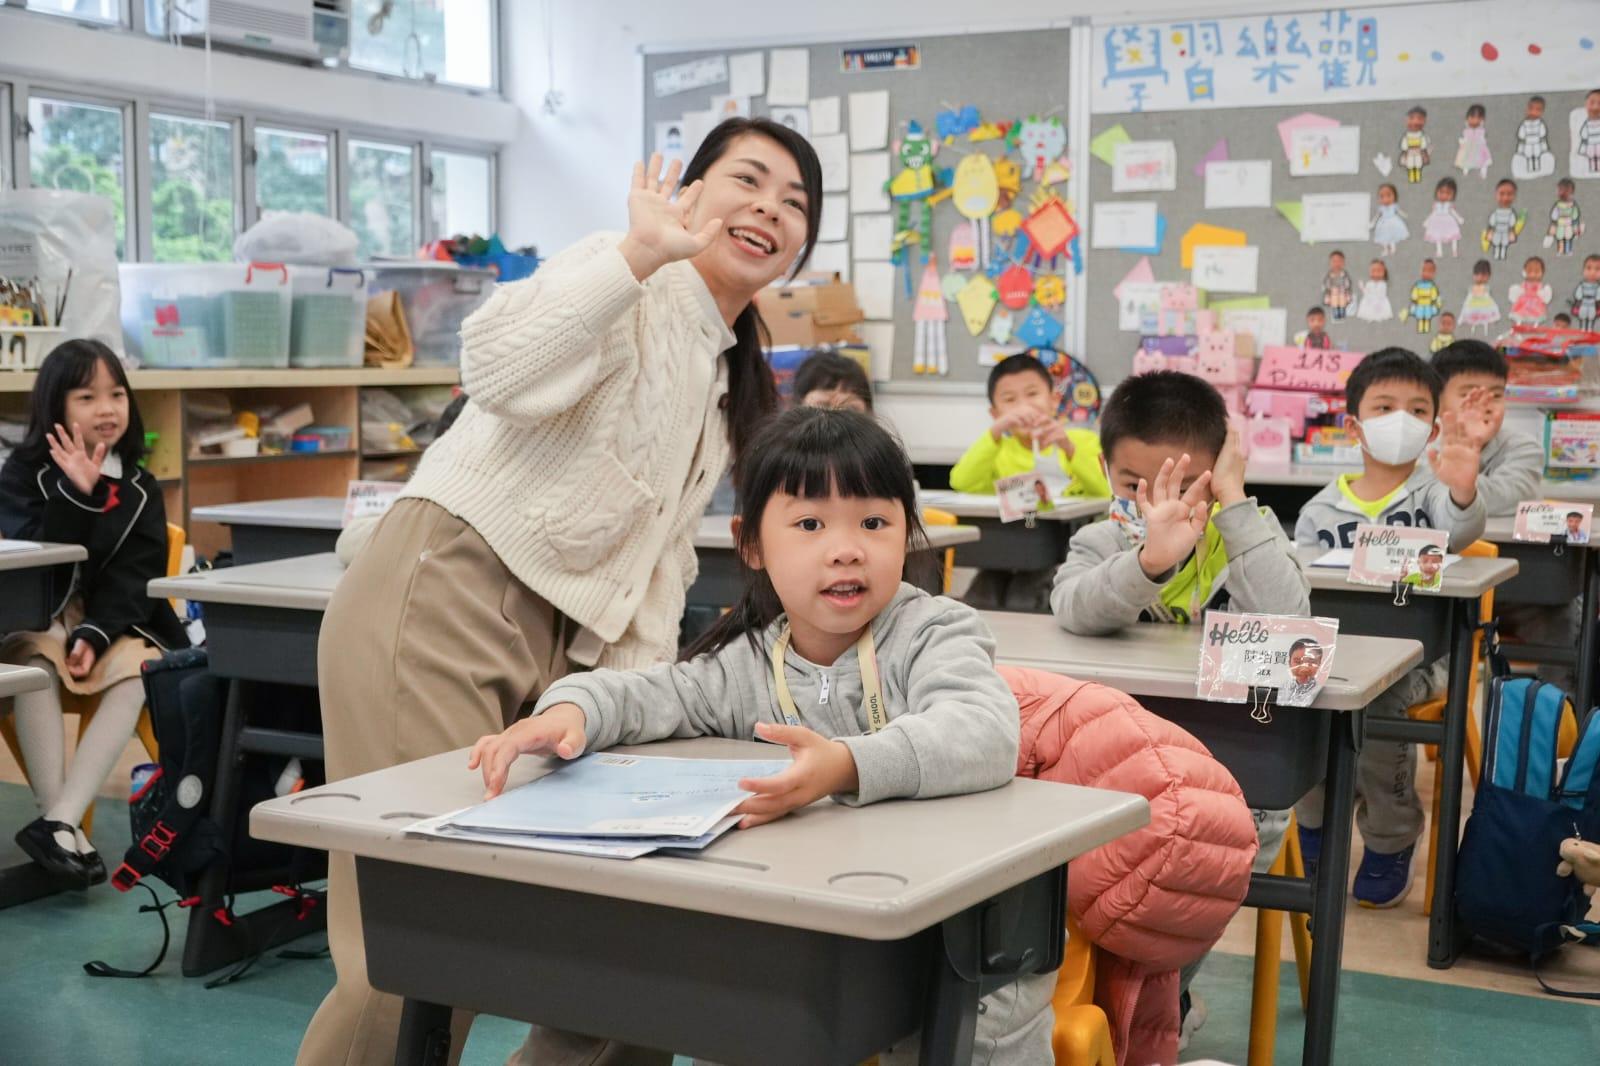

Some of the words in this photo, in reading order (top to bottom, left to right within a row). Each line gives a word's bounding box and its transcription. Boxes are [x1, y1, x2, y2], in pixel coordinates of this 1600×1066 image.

[1358, 529, 1400, 548] Hello
[1209, 620, 1269, 647] Hello
[870, 692, 881, 724] SCHOOL
